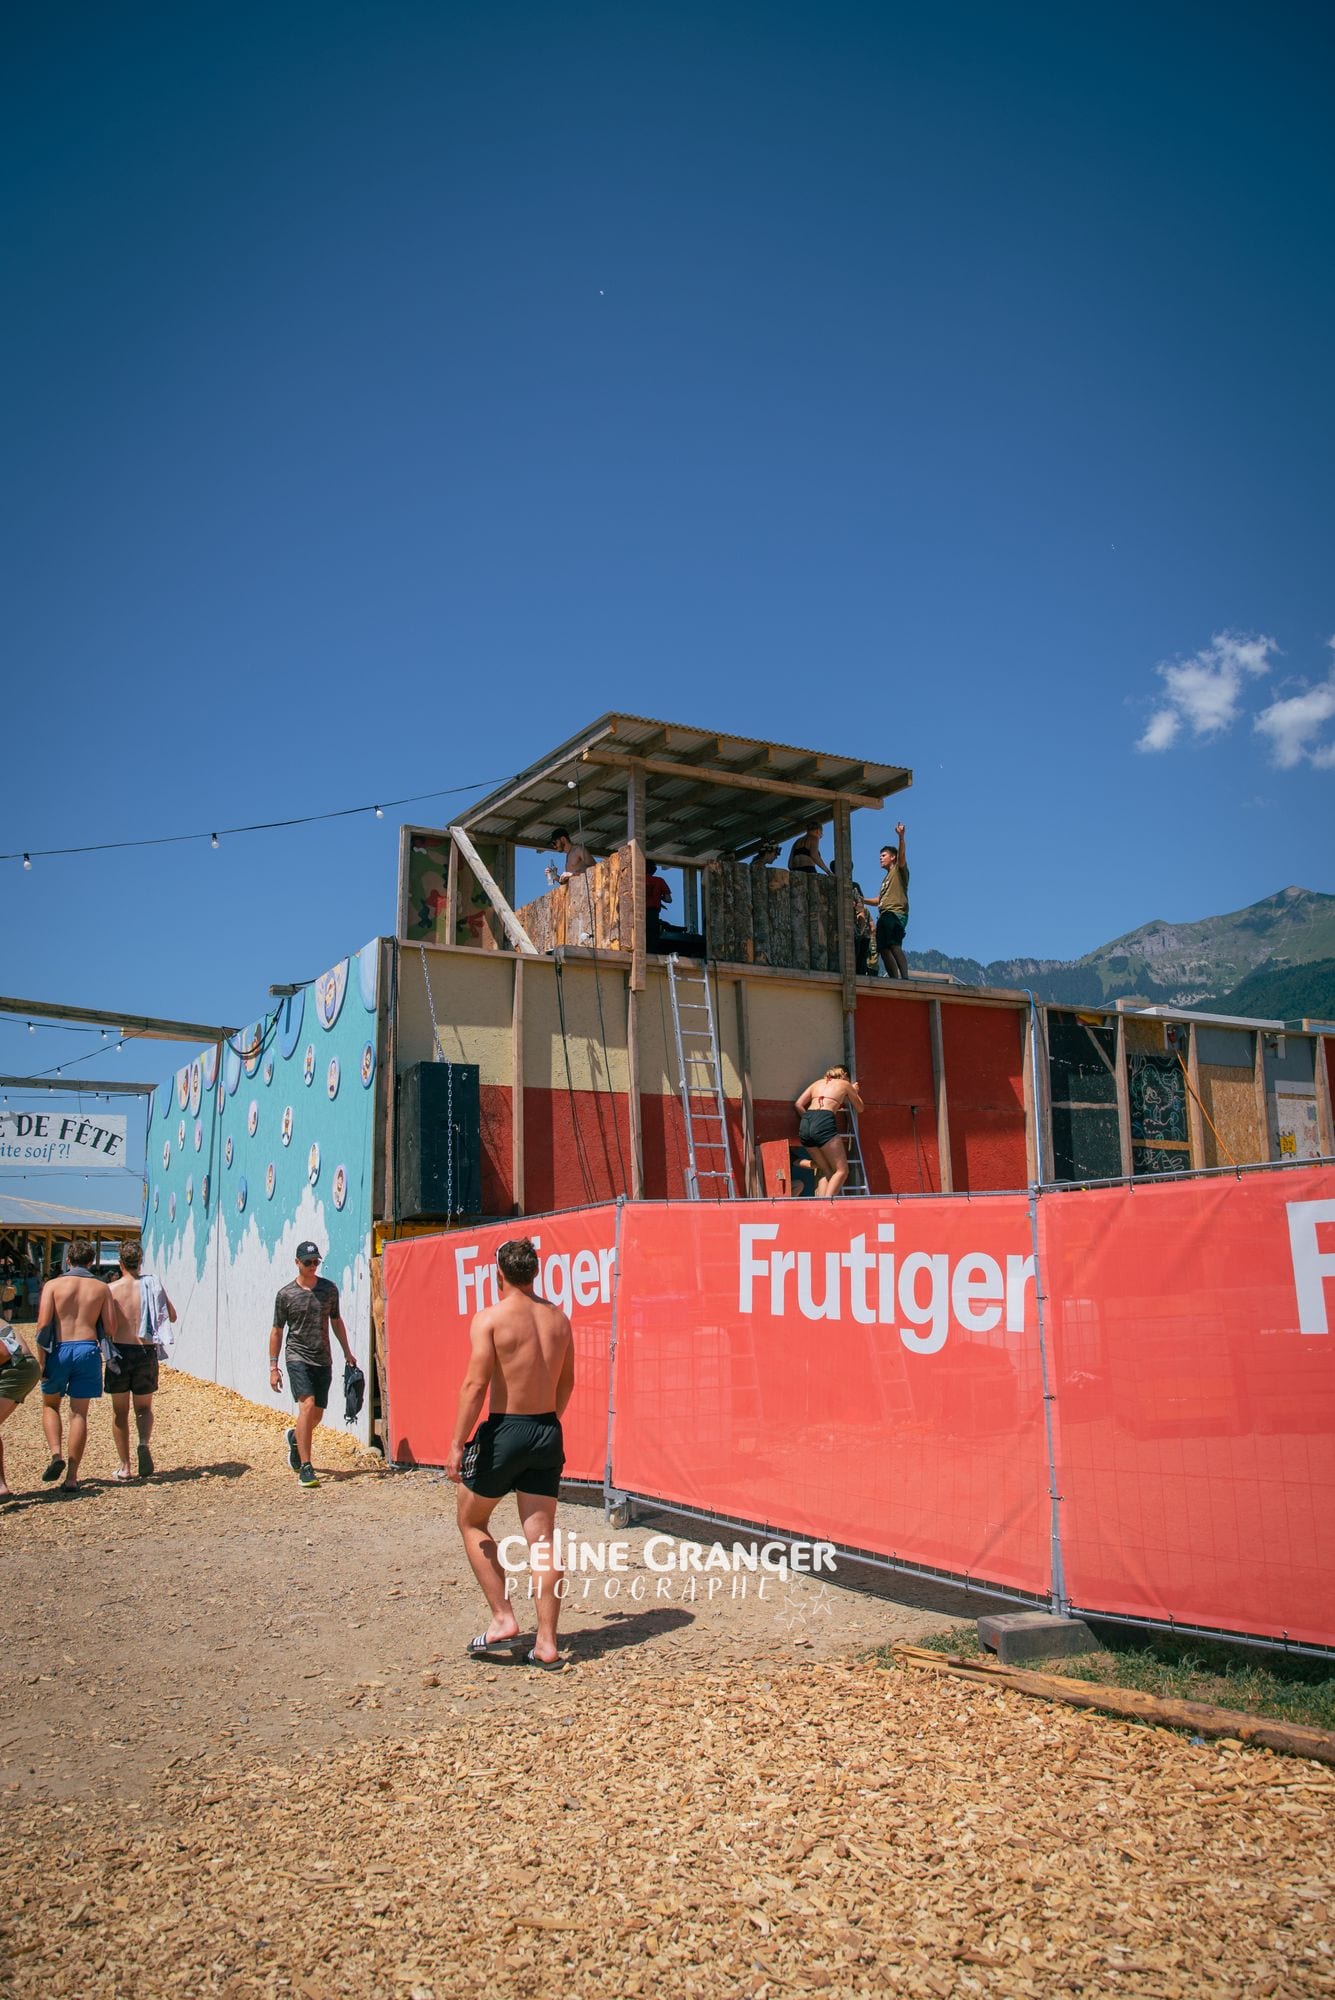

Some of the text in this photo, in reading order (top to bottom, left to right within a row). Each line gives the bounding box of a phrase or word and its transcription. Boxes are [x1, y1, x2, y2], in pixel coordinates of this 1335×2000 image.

[0, 1143, 71, 1162] ite soif ?!
[17, 1115, 50, 1137] DE
[59, 1118, 123, 1156] FÊTE
[455, 1235, 618, 1320] Friger
[739, 1223, 1036, 1355] Frutiger
